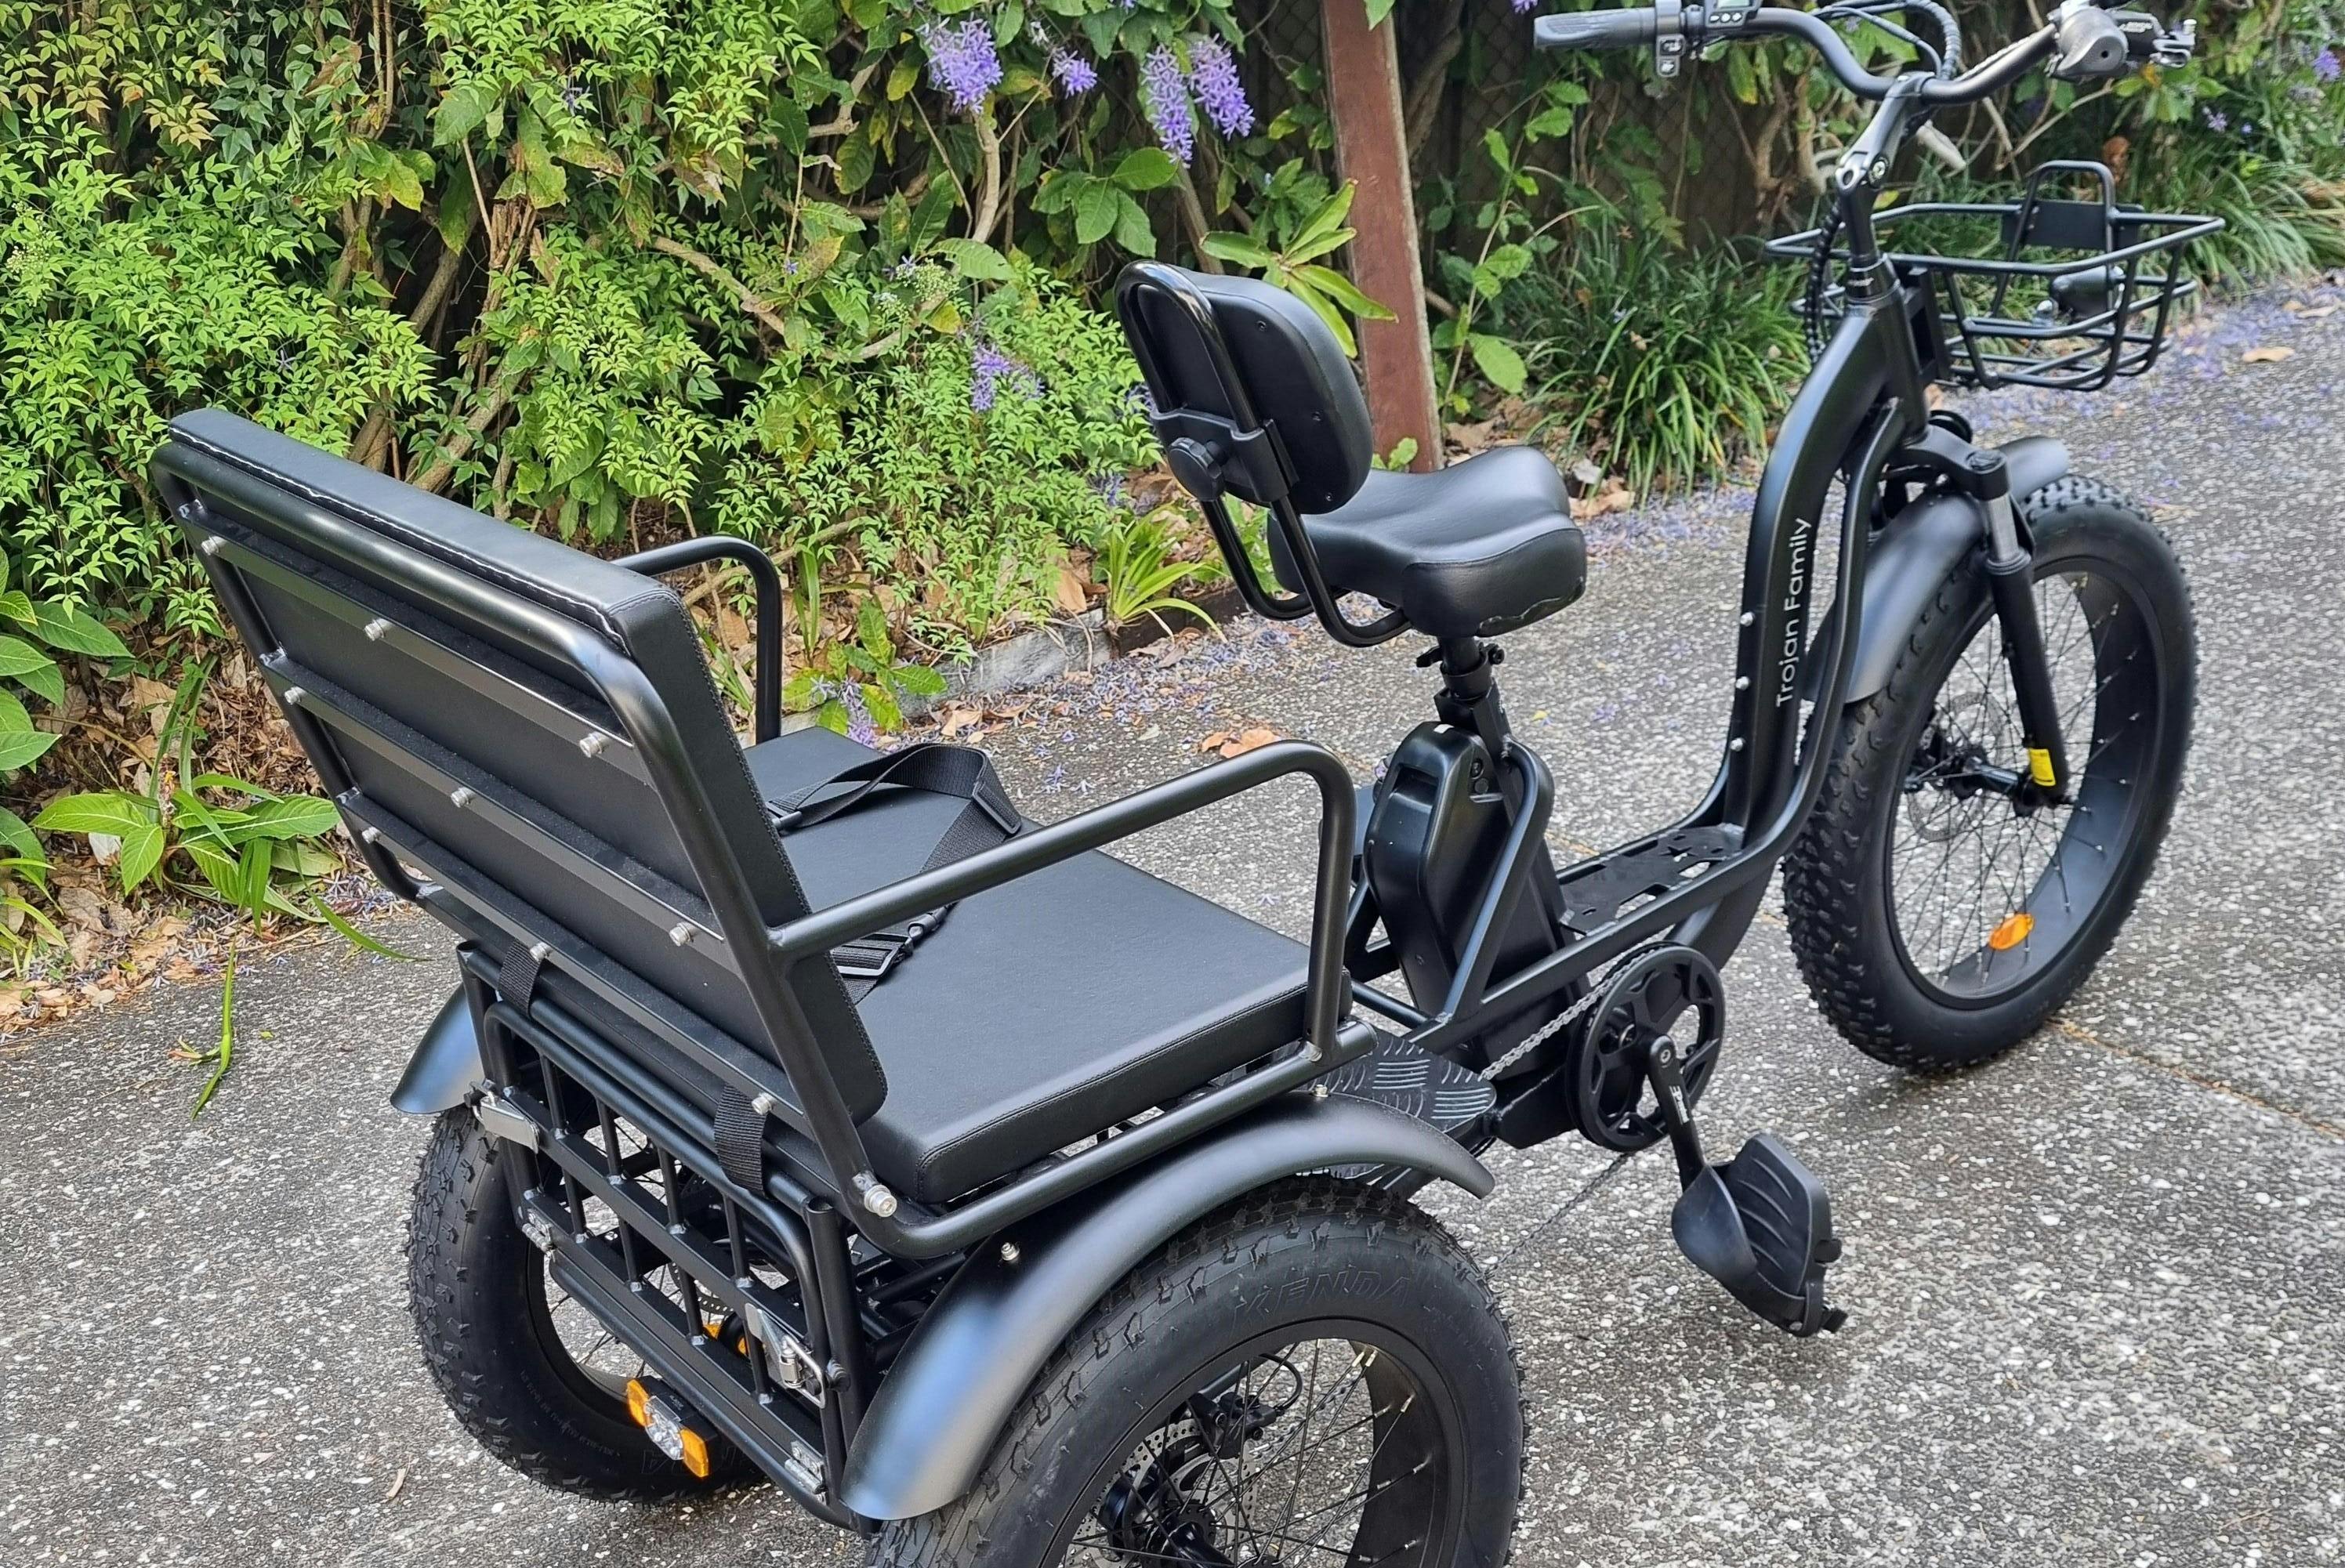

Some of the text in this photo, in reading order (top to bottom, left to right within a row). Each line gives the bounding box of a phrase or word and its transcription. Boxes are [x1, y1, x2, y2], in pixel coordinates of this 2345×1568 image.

[1775, 517, 1812, 708] Trojan Family
[1231, 1269, 1412, 1334] KENDA
